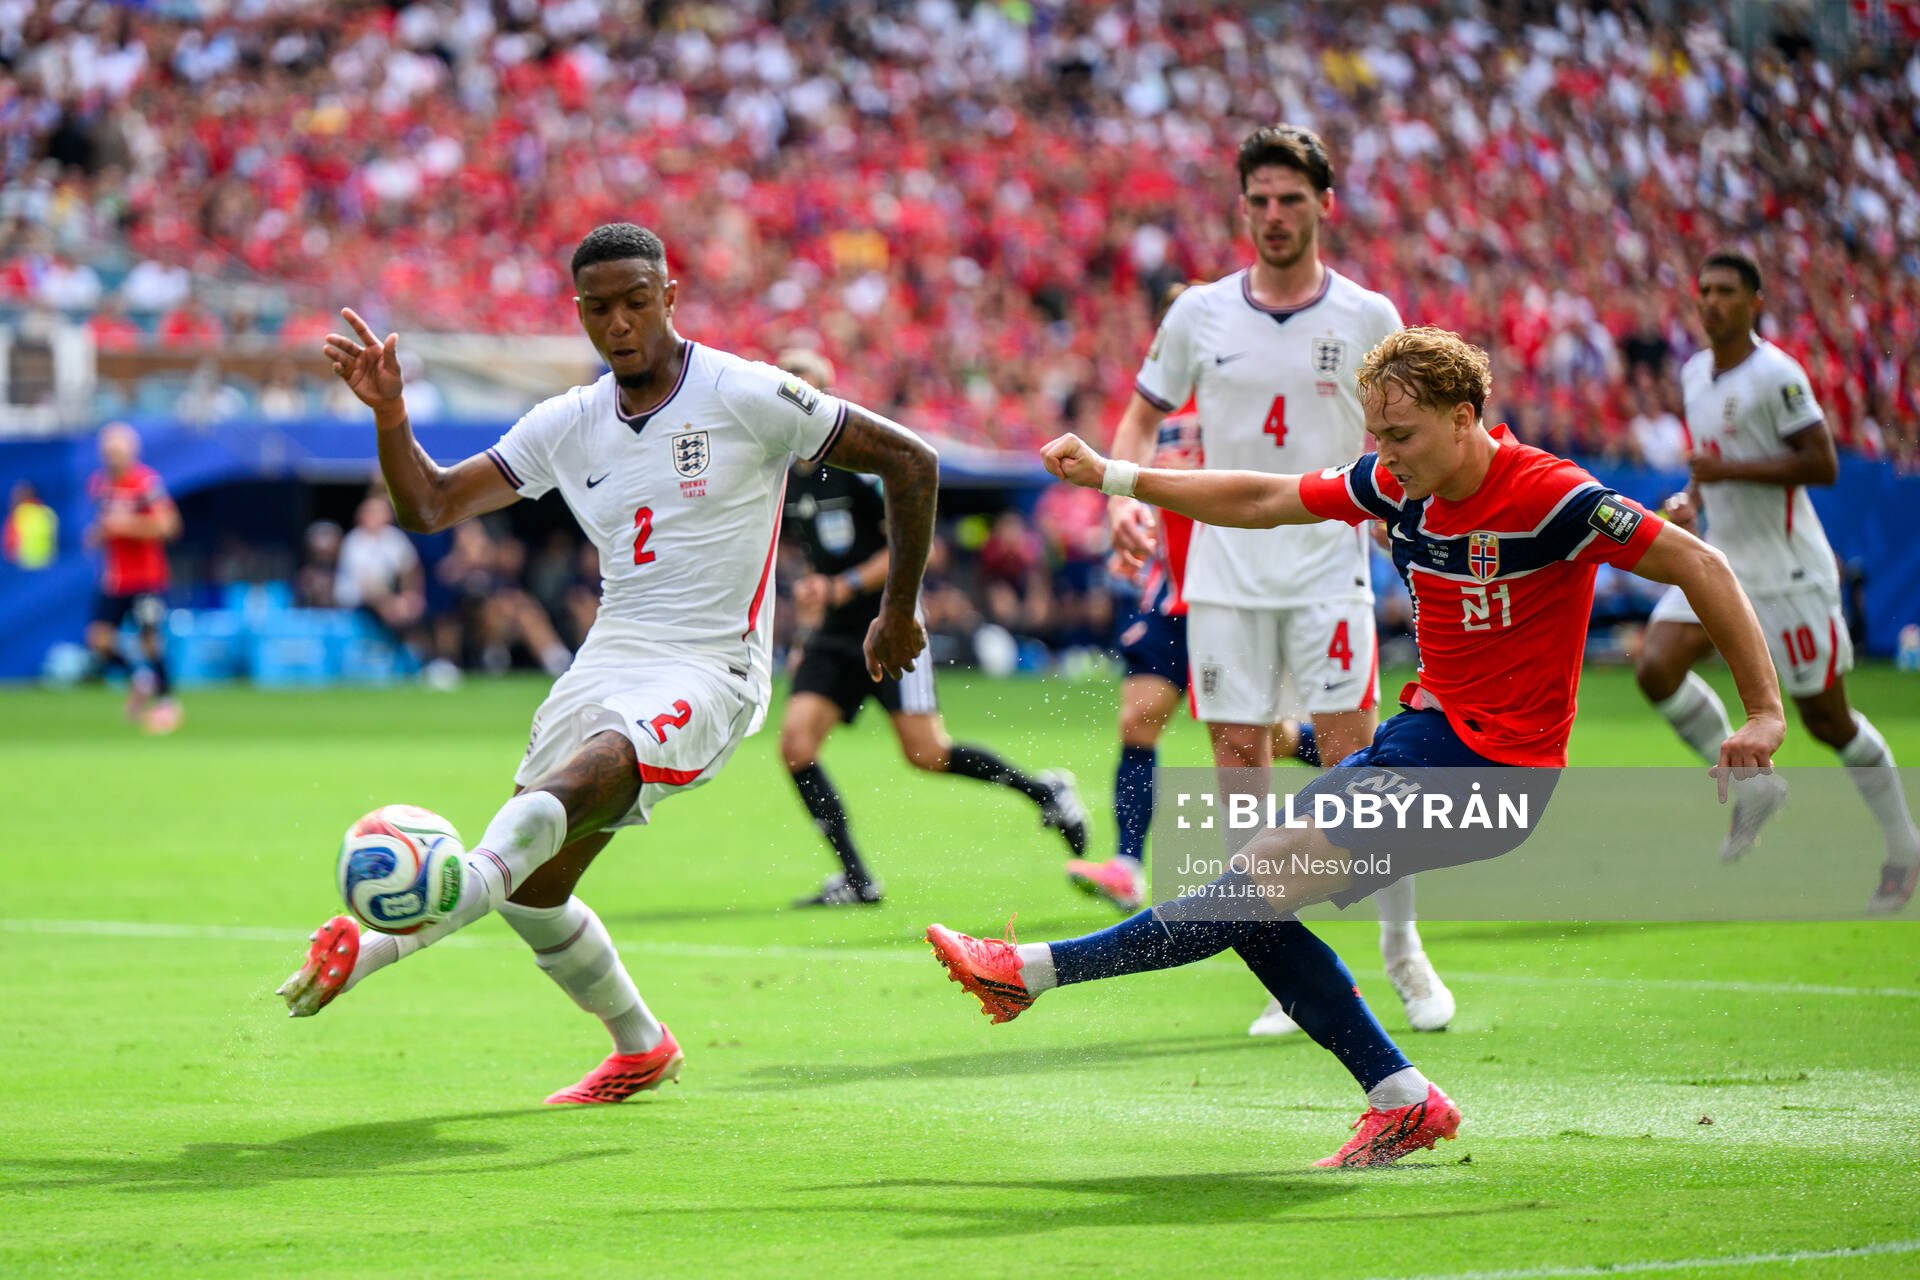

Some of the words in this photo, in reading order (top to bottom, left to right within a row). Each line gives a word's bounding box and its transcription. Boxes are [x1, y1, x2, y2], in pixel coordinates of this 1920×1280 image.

[1263, 394, 1288, 447] 4
[634, 506, 656, 566] 2
[1460, 583, 1512, 632] 21
[1328, 619, 1354, 671] 4
[1782, 626, 1817, 667] 10
[650, 699, 692, 744] 2
